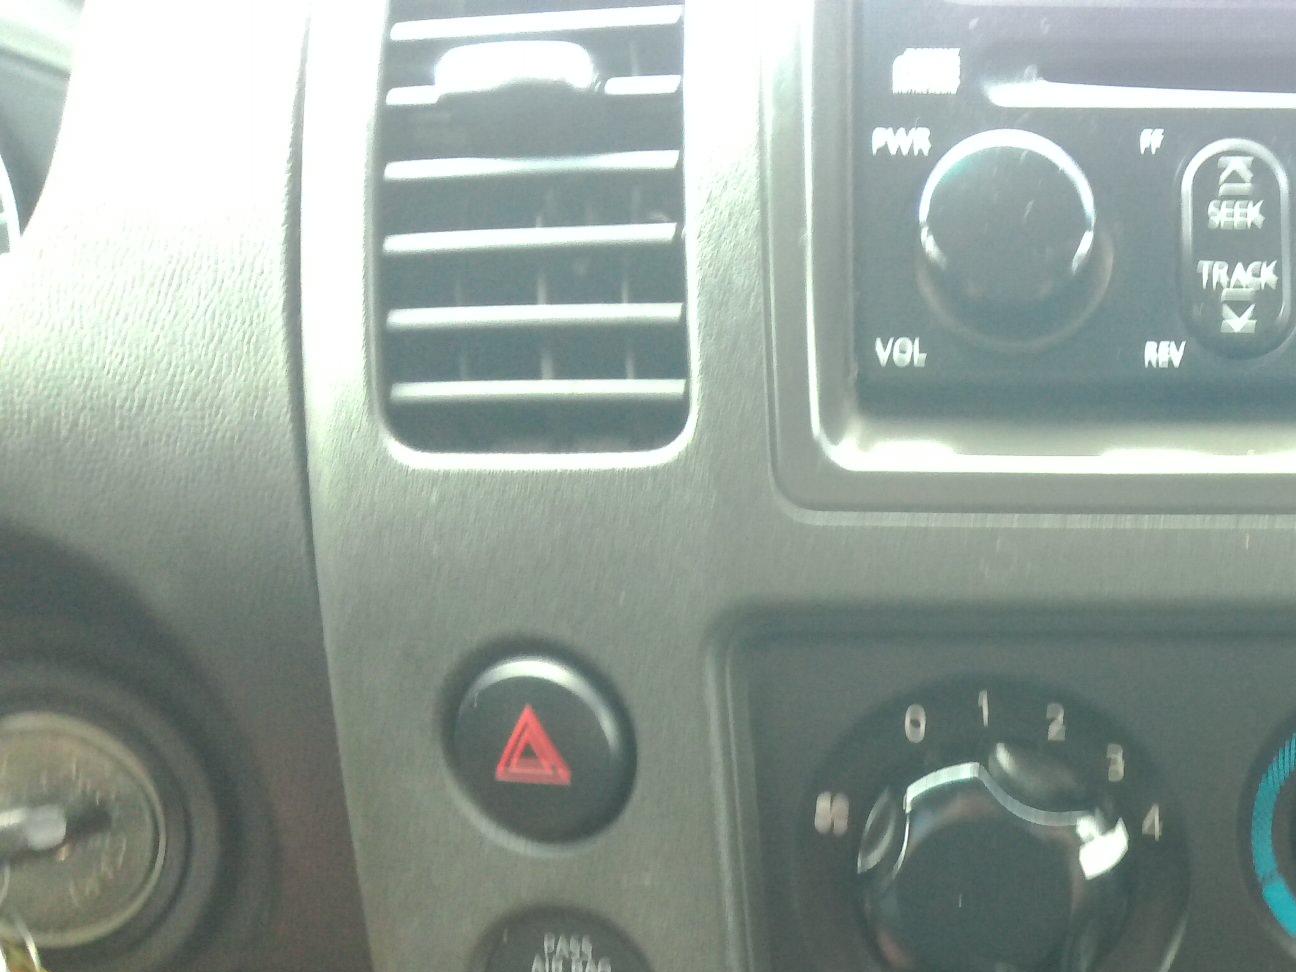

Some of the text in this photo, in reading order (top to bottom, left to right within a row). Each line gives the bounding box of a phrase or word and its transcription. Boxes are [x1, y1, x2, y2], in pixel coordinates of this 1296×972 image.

[871, 126, 931, 156] PWR
[1139, 127, 1164, 155] FF
[1207, 199, 1265, 230] SEEK
[1197, 259, 1280, 290] TRACK
[874, 337, 928, 368] VOL
[1144, 340, 1186, 369] REV
[904, 703, 927, 744] 0
[978, 690, 989, 728] 1
[1046, 702, 1067, 742] 2
[1106, 743, 1125, 783] 3
[1142, 803, 1162, 842] 4
